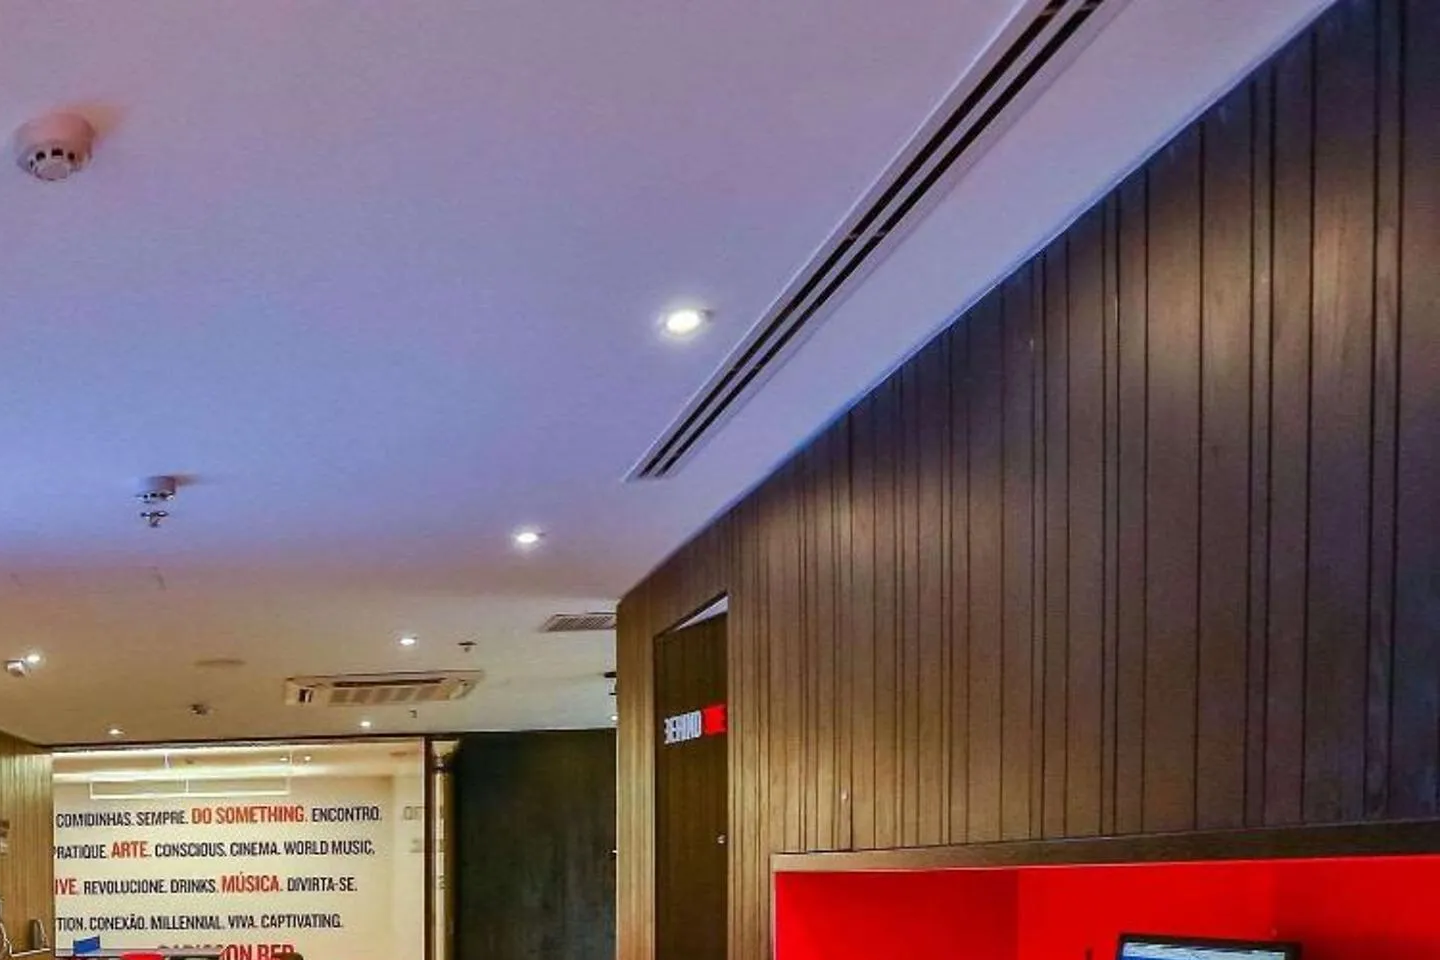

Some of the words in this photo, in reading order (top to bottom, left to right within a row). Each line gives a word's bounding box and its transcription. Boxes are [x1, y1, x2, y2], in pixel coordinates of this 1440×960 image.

[56, 812, 134, 828] COMIDINHAS.
[136, 810, 188, 826] SEMPRE.
[191, 807, 212, 825] DO
[215, 805, 308, 825] SOMETHING.
[311, 806, 382, 822] ENCONTRO.
[111, 841, 152, 859] ARTE.
[155, 842, 227, 858] CONSCIOUS.
[230, 841, 281, 857] CINEMA.
[283, 840, 328, 856] WORLD
[221, 871, 283, 894] MÚSICA.
[287, 876, 358, 892] DIVIRTA-SE.
[90, 913, 148, 931] CONEXÃO.
[151, 915, 225, 930] MILLENNIAL.
[228, 914, 258, 929] VIVA.
[261, 913, 343, 929] CAPTIVATING.
